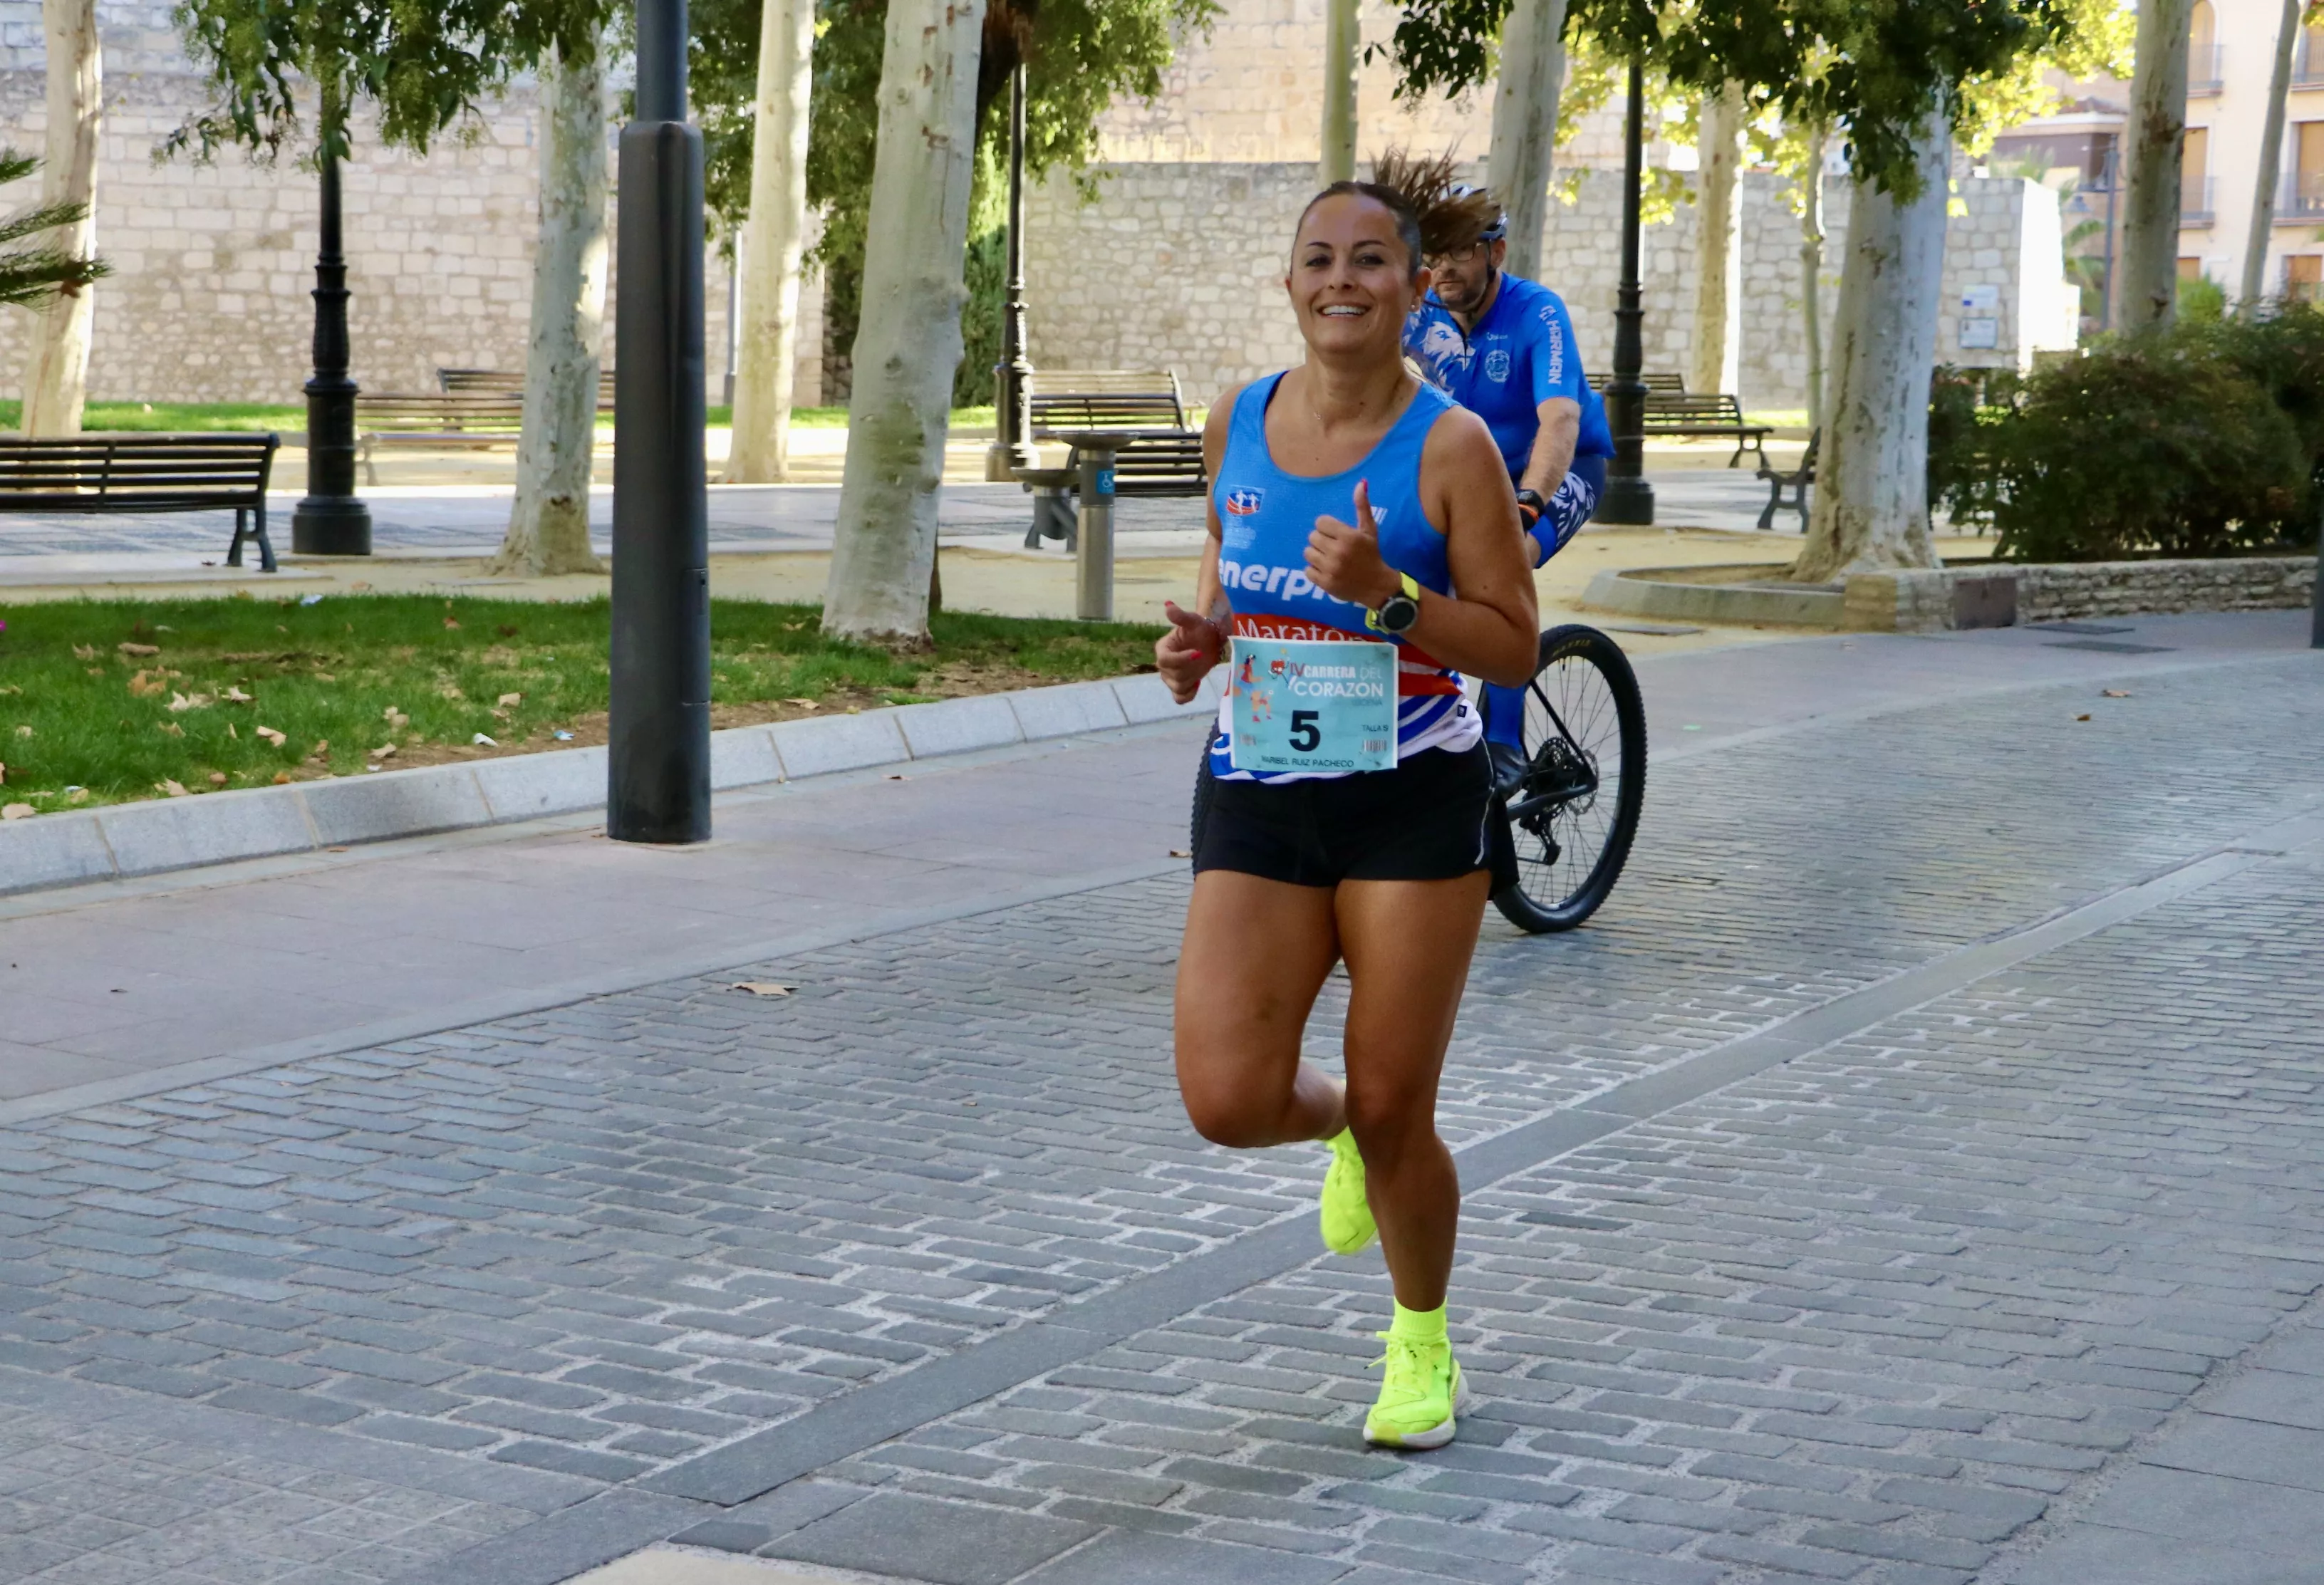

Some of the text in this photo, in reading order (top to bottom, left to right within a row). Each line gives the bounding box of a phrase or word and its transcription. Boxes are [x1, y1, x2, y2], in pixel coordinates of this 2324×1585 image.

[1546, 319, 1563, 385] HARMAN
[1304, 665, 1356, 678] CARRERA
[1359, 667, 1382, 679] DEL
[1289, 710, 1321, 752] 5
[1292, 758, 1310, 766] RUIZ
[1312, 759, 1354, 768] PACHECO
